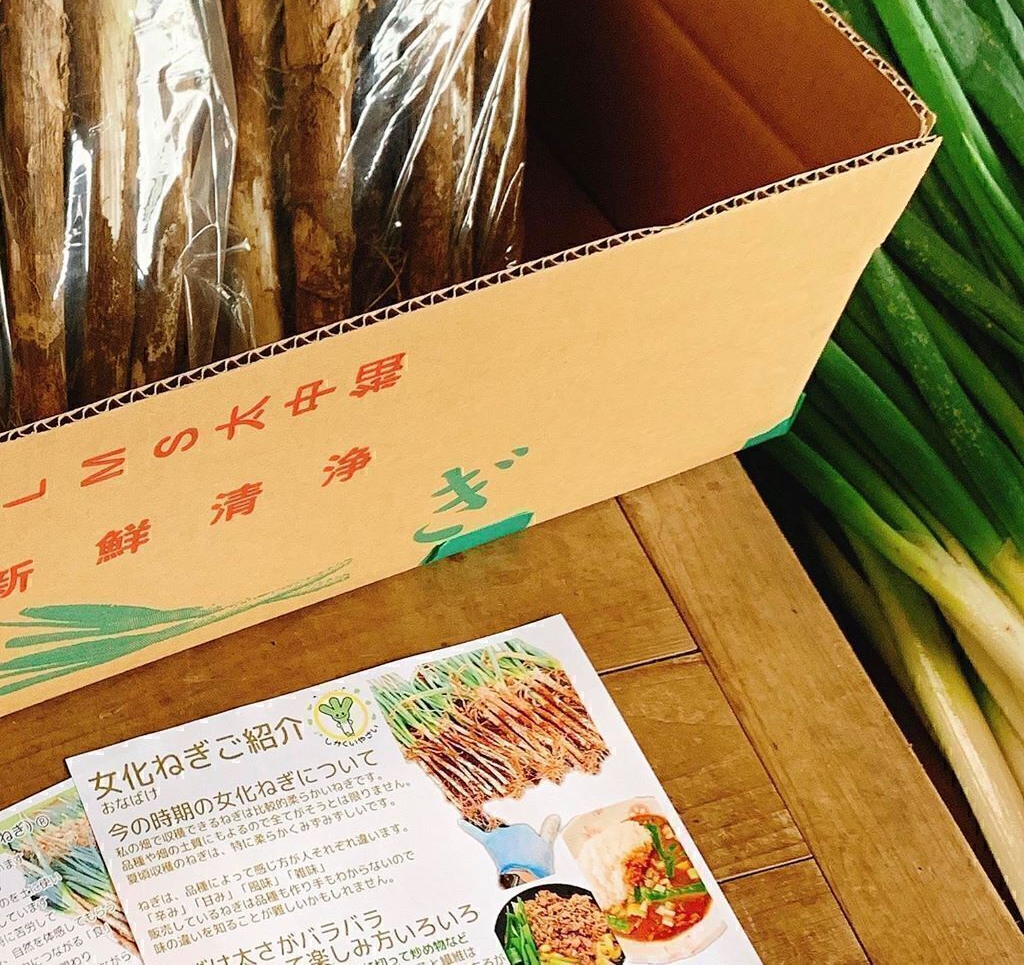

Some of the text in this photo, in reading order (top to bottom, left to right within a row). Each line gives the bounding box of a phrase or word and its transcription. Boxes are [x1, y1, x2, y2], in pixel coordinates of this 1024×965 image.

[3, 478, 47, 509] L
[80, 446, 127, 488] M
[153, 427, 200, 459] S
[413, 446, 529, 544] ぎ
[88, 716, 303, 800] 女化ねぎご紹介
[106, 749, 379, 845] 今の時期の女化ねぎについて
[99, 786, 159, 815] おなばけ
